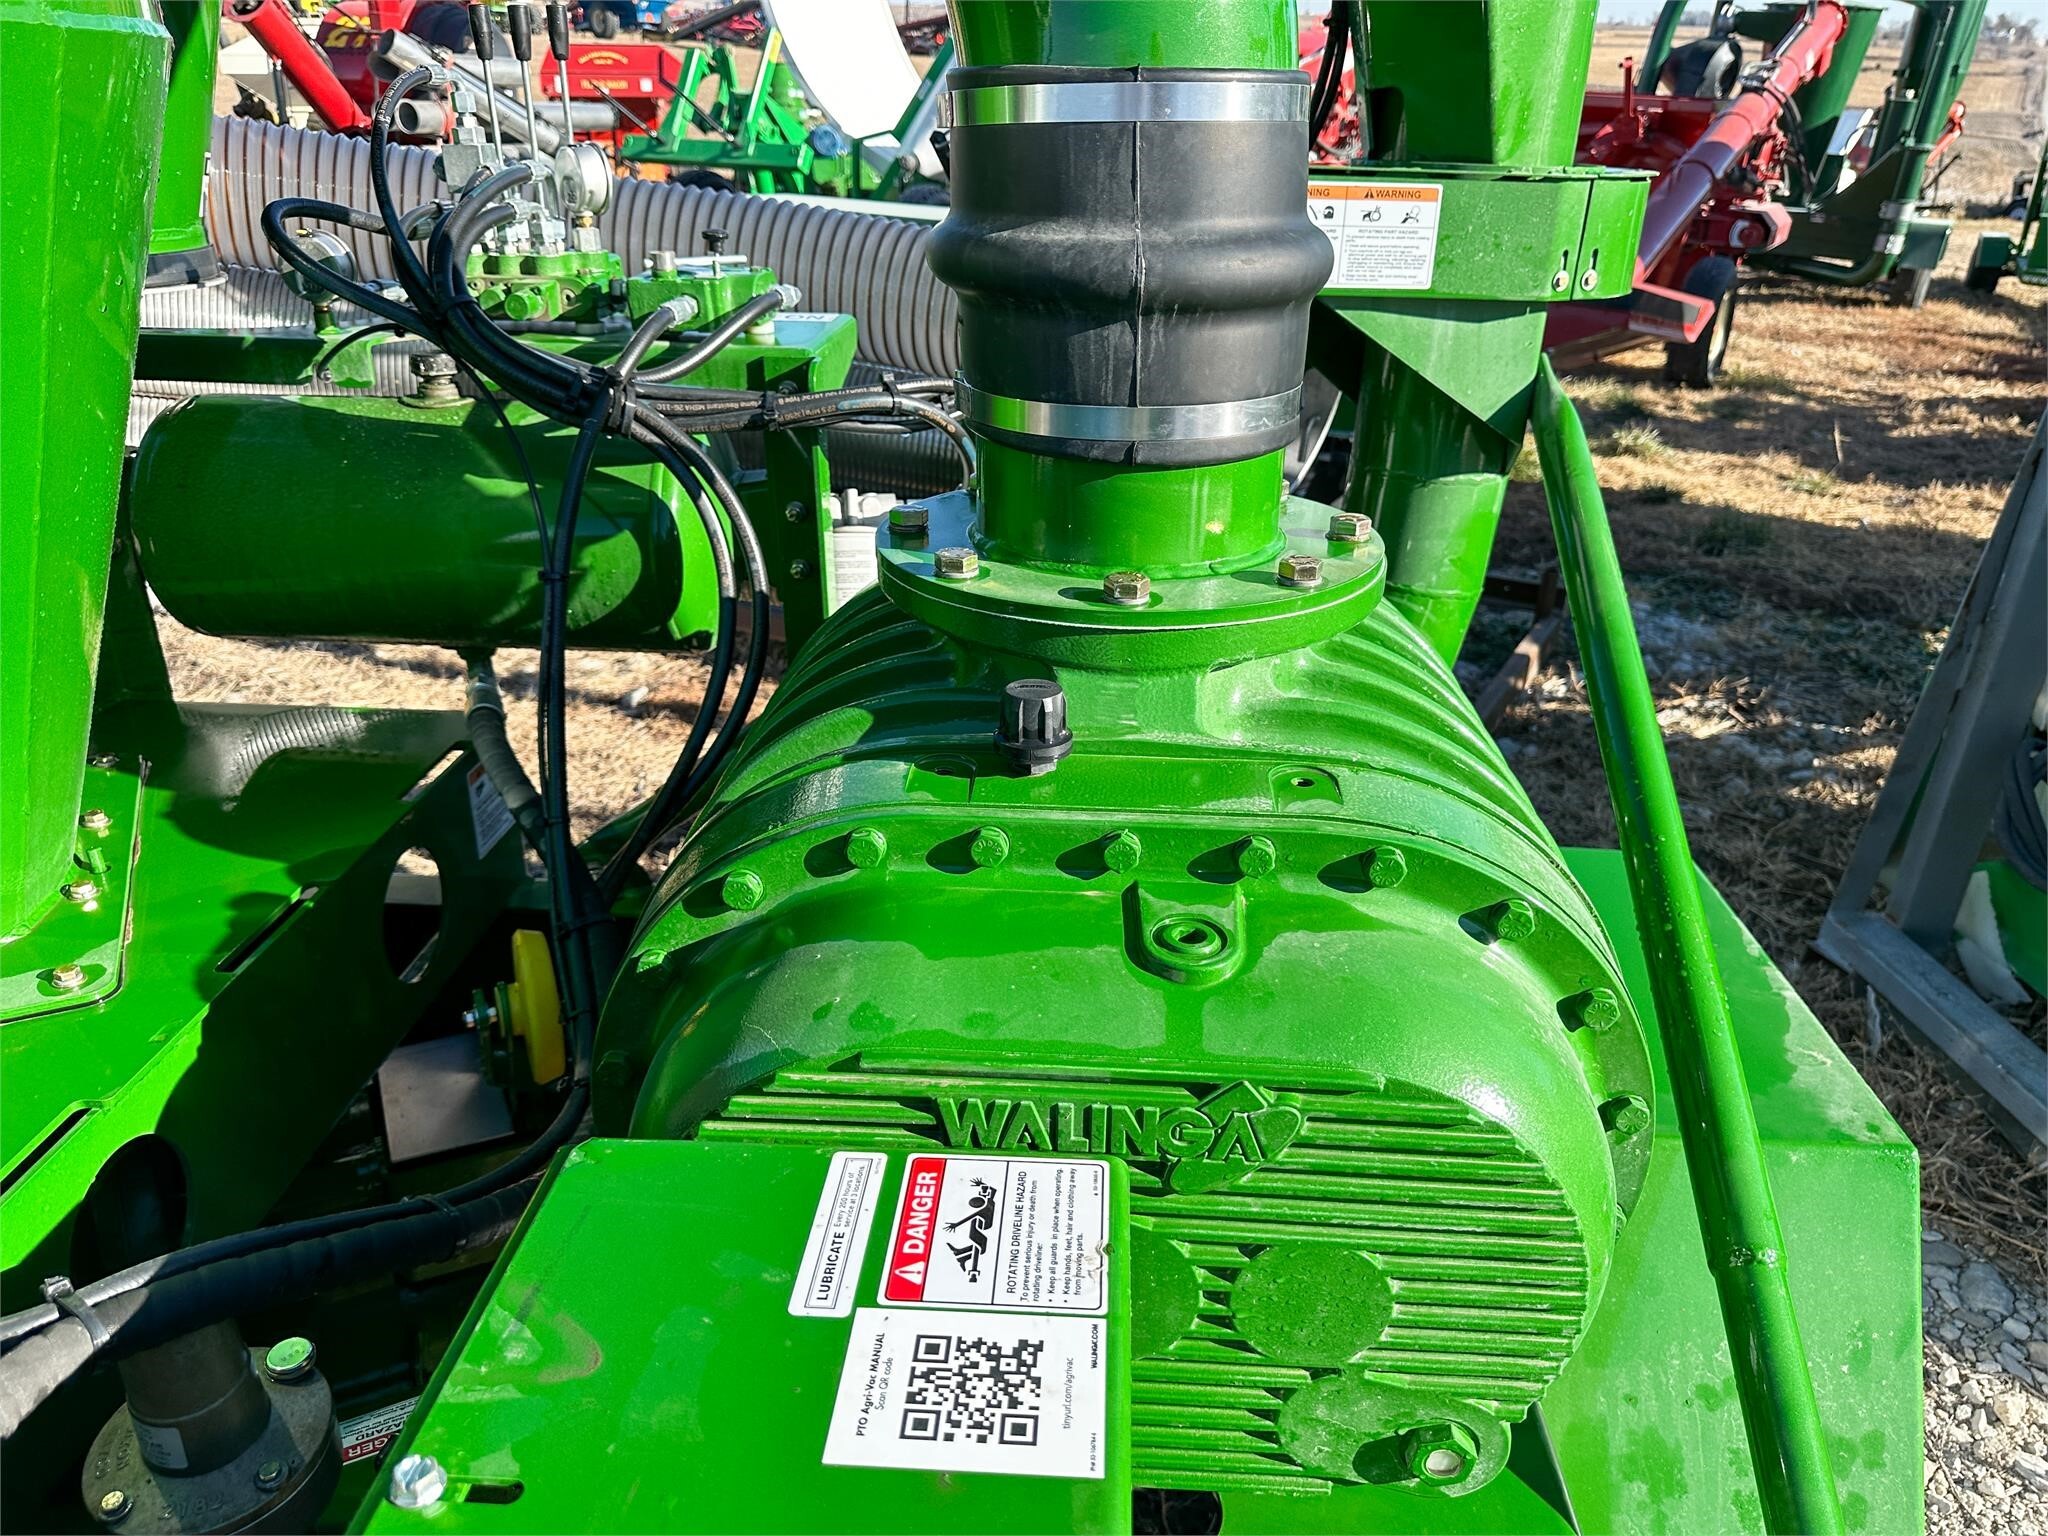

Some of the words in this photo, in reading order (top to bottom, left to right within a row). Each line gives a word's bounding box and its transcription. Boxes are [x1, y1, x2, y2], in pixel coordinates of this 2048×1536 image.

[1308, 188, 1330, 197] NING
[1375, 189, 1421, 199] WARNING
[936, 1097, 1265, 1164] WALINGA
[1015, 1171, 1027, 1203] HAZARD
[1067, 1186, 1076, 1208] clothing
[834, 1208, 844, 1227] Every
[842, 1178, 852, 1197] hours
[844, 1205, 854, 1227] service
[849, 1197, 856, 1206] at
[902, 1171, 938, 1254] DANGER
[1028, 1195, 1036, 1212] death
[1052, 1215, 1060, 1233] place
[1066, 1208, 1074, 1222] and
[1011, 1204, 1024, 1247] DRIVELINE
[1026, 1221, 1035, 1239] injury
[1065, 1222, 1073, 1237] hair
[1024, 1239, 1033, 1264] serious
[1050, 1243, 1058, 1265] guards
[1064, 1236, 1073, 1252] feet,
[816, 1231, 845, 1301] LUBRICATE
[1006, 1249, 1020, 1294] ROTATING
[1048, 1266, 1056, 1275] all
[1063, 1253, 1073, 1275] hands,
[1075, 1252, 1085, 1278] moving
[1023, 1265, 1031, 1291] prevent
[1047, 1276, 1057, 1294] Keep
[1062, 1276, 1071, 1295] Keep
[1073, 1279, 1081, 1296] from
[1020, 1292, 1028, 1302] To
[1033, 1275, 1042, 1302] rotating
[869, 1332, 885, 1372] MANUAL
[882, 1357, 893, 1375] code
[879, 1377, 889, 1389] QR
[860, 1375, 877, 1414] Agri-Vac
[874, 1391, 887, 1411] Scan
[1061, 1357, 1075, 1430] tinyurl.com/agrivac
[356, 1421, 402, 1441] AZARD
[856, 1417, 868, 1436] PTO
[349, 1438, 388, 1457] GER
